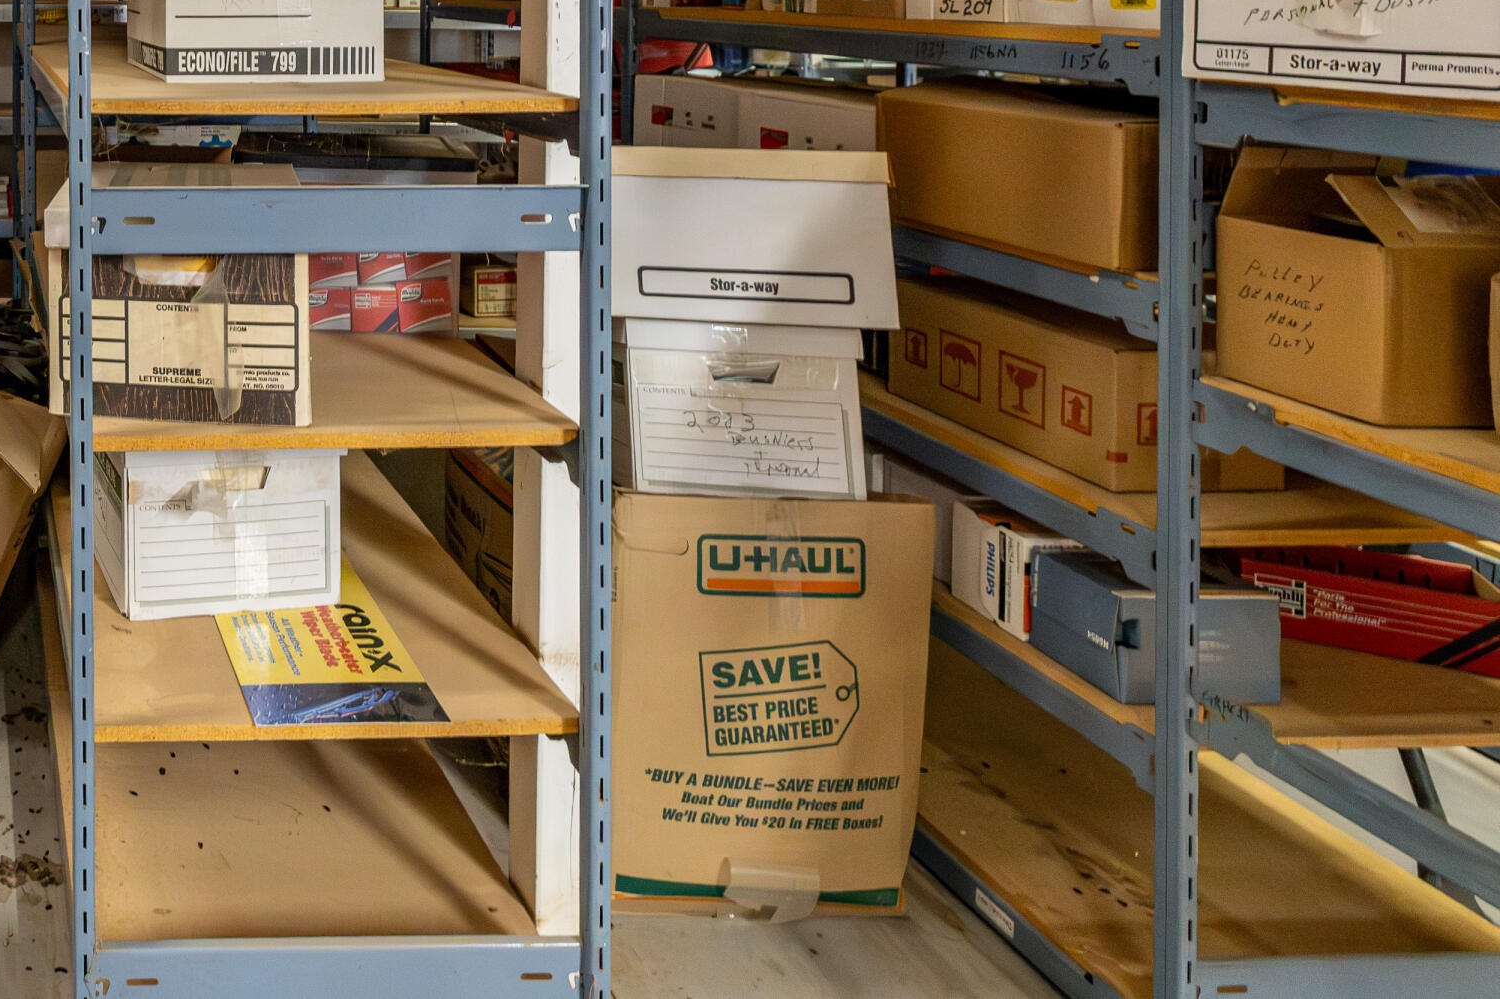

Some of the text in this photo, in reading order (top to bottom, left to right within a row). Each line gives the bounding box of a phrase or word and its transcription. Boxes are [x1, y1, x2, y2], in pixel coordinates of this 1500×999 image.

[270, 51, 297, 73] 799
[1061, 48, 1110, 70] 1156
[1289, 54, 1382, 77] Stor-a-way
[1411, 61, 1444, 73] Perma
[709, 277, 780, 295] Stor-a-way
[138, 375, 196, 385] LETTER-LEGAL
[152, 367, 202, 377] SUPREME
[708, 544, 855, 575] U-HAUL
[985, 541, 996, 597] PHILIPS
[300, 610, 341, 668] Wiper Blade
[711, 651, 822, 690] SAVE!
[712, 696, 819, 724] BEST PRICE
[686, 771, 699, 787] A
[817, 778, 855, 793] EVEN
[856, 775, 901, 792] MORE!
[680, 790, 865, 812] Beat Our Bundle Prices and
[700, 810, 731, 827] Give
[734, 814, 759, 828] You
[761, 815, 786, 829] $20
[804, 816, 839, 831] FREE
[841, 814, 883, 830] Boxes!
